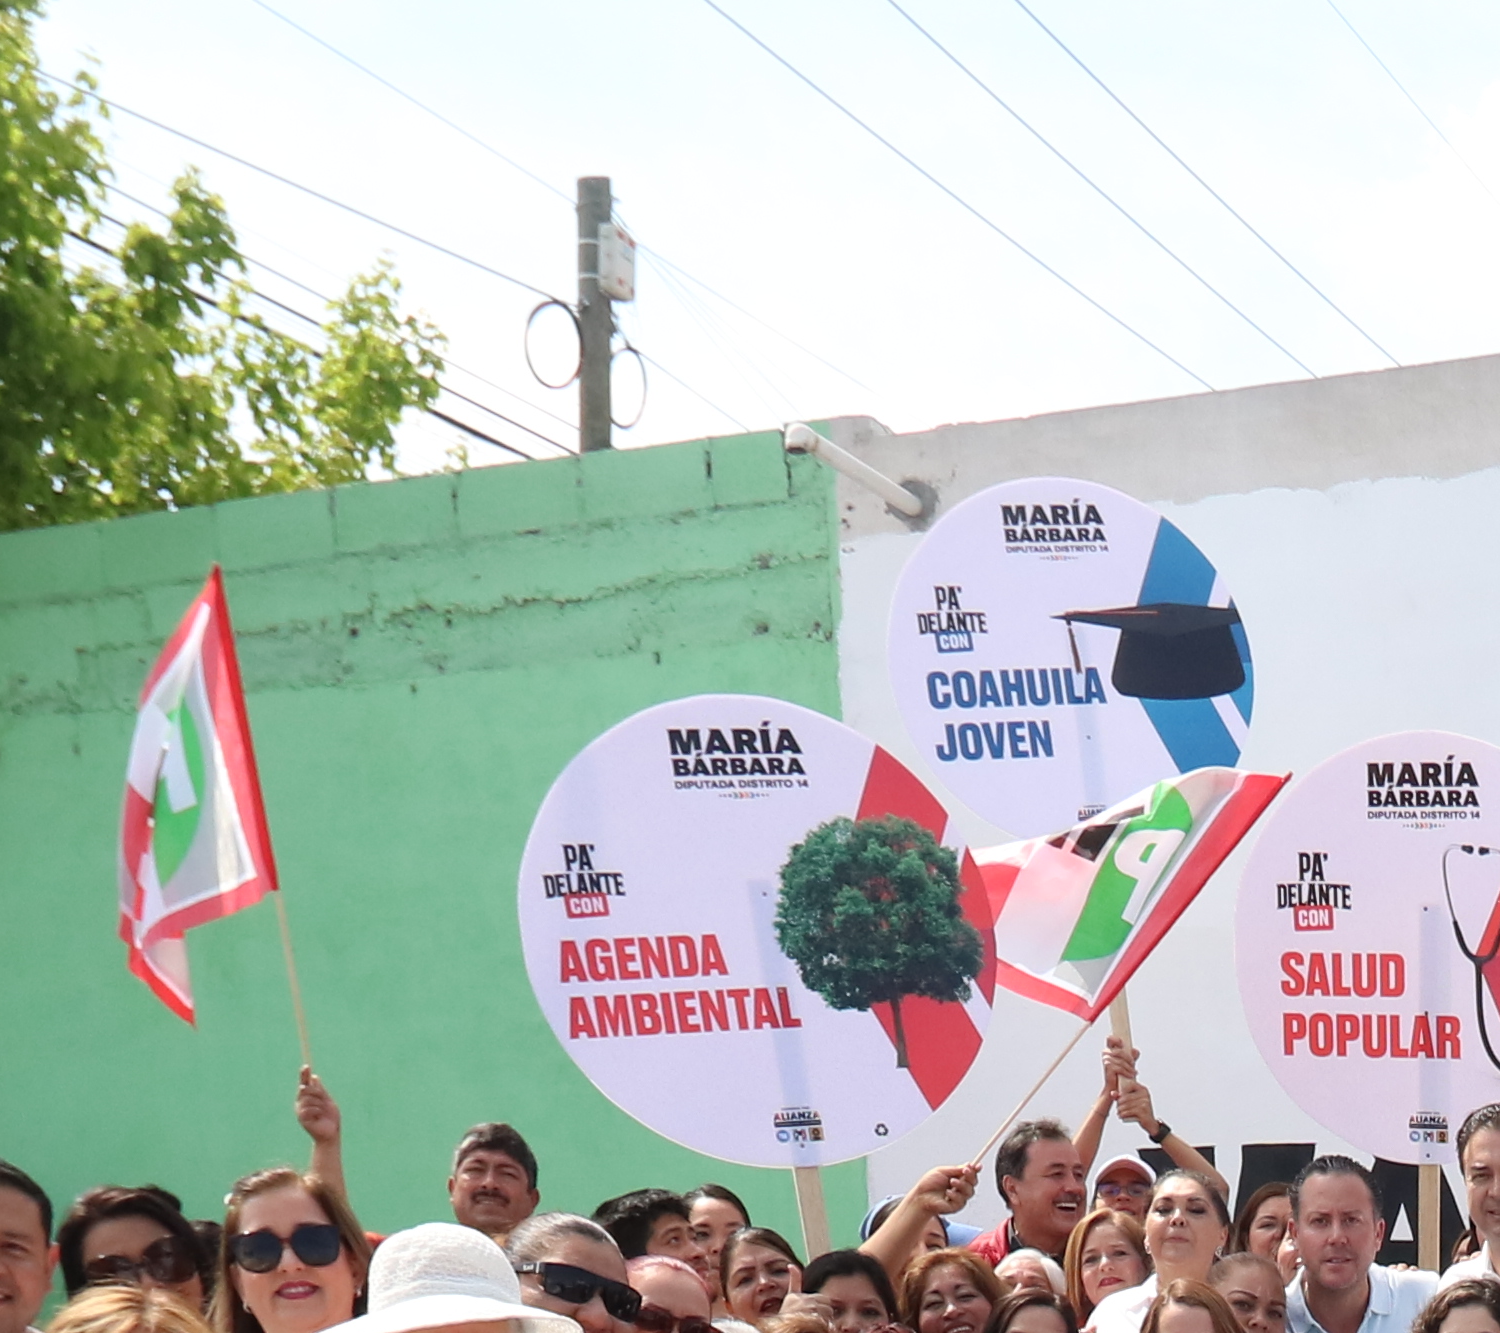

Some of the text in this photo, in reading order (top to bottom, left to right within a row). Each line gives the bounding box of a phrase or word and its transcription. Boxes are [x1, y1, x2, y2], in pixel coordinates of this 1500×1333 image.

[1001, 498, 1105, 526] MARÍA
[1003, 523, 1108, 543] BÁRBARA
[1005, 545, 1053, 554] DIPUTADA
[1055, 545, 1097, 553] DISTRITO
[934, 585, 962, 611] PA'
[916, 612, 988, 635] DELANTE
[939, 633, 970, 650] CON
[926, 667, 1107, 709] COAHUILA
[666, 720, 803, 755] MARÍA
[935, 720, 1054, 762] JOVEN
[671, 753, 806, 777] BÁRBARA
[1366, 754, 1480, 788] MARÍA
[674, 779, 809, 790] DIPUTADA DISTRITO 14
[1367, 785, 1480, 808] BÁRBARA
[1367, 810, 1480, 820] DIPUTADA DISTRITO 14
[562, 843, 595, 872] PA'
[1298, 851, 1329, 882] PA'
[542, 872, 626, 899] DELANTE
[1276, 883, 1352, 910] DELANTE
[569, 897, 606, 915] CON
[1298, 909, 1330, 927] CON
[560, 933, 729, 983] AGENDA
[1280, 951, 1405, 998] SALUD
[569, 986, 803, 1040] AMBIENTAL
[1283, 1012, 1461, 1059] POPULAR
[773, 1111, 820, 1121] ALIANZA
